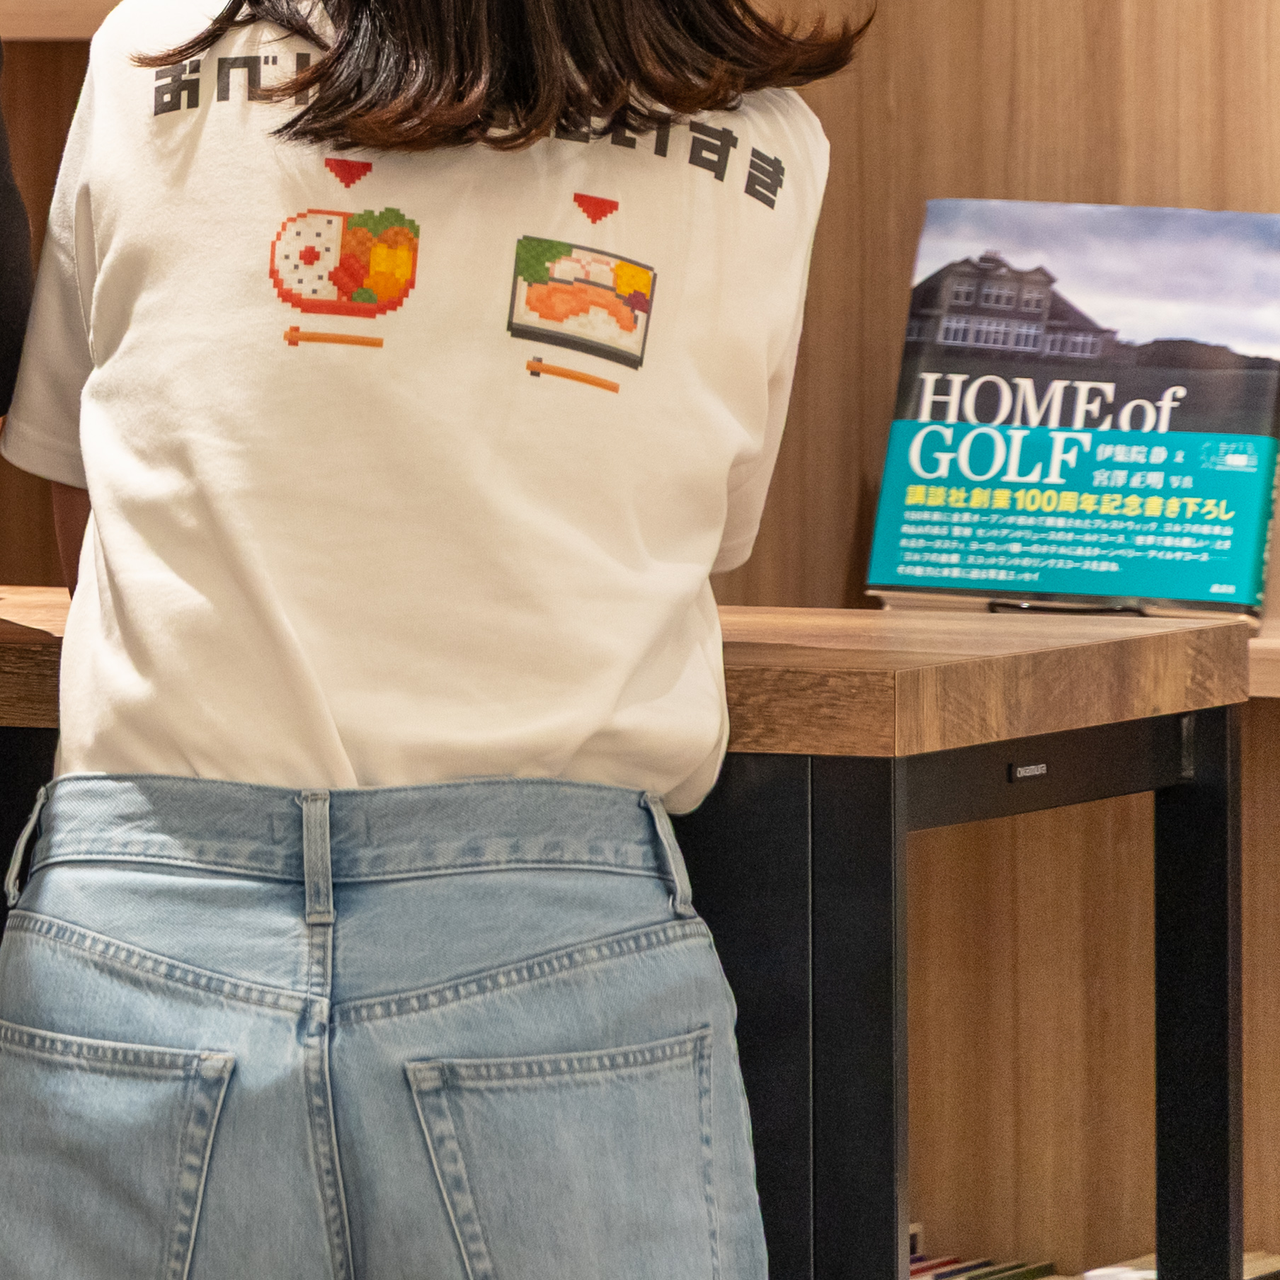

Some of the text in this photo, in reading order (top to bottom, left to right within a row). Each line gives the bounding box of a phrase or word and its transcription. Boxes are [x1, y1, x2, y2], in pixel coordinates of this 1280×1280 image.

[917, 371, 1188, 435] HOME of
[908, 423, 1093, 485] GOLF
